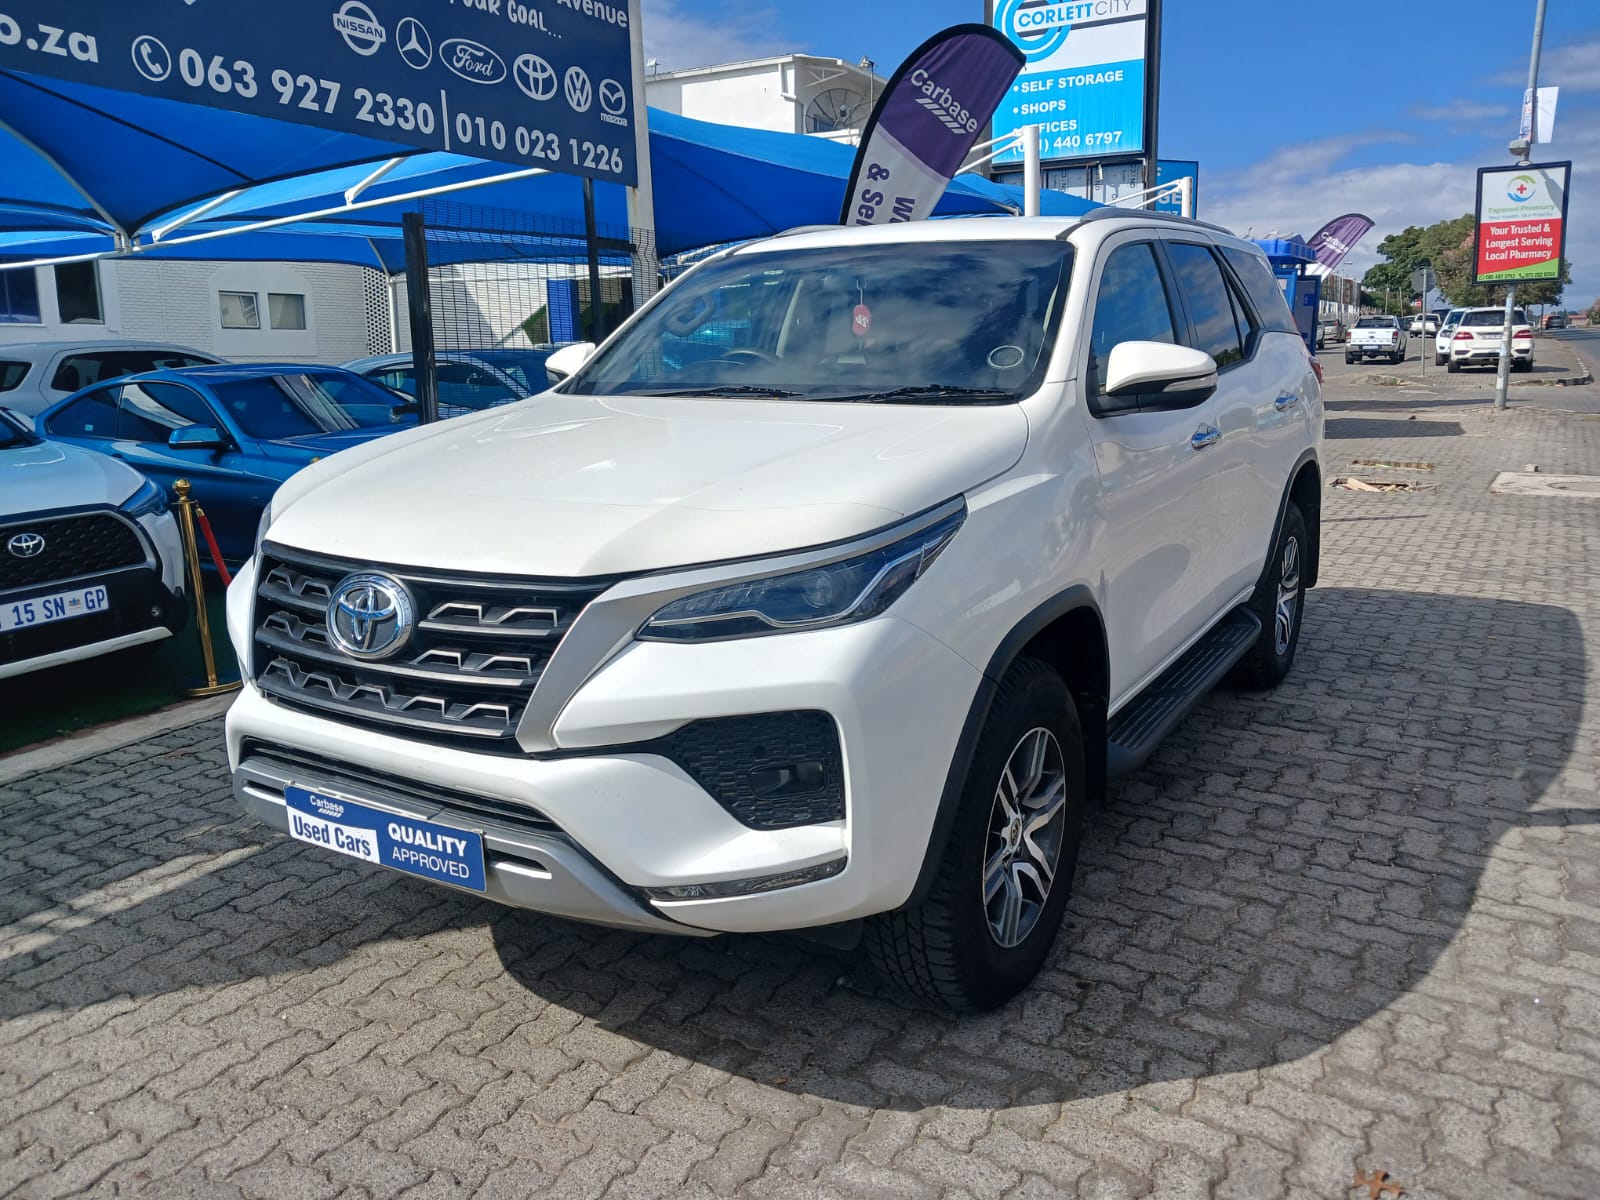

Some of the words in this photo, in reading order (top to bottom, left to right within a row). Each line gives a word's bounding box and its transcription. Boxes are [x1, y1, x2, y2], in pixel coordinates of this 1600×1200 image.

[336, 17, 383, 39] NISSAN
[452, 44, 493, 77] Ford
[178, 48, 258, 98] 063
[271, 68, 341, 114] 927
[353, 87, 435, 135] 2330
[1021, 79, 1054, 93] SELF
[1057, 70, 1125, 89] STORAGE
[910, 68, 978, 132] Carbase
[1020, 99, 1067, 115] SHOPS
[600, 112, 628, 127] mazda
[455, 112, 506, 151] 010
[515, 126, 561, 161] 023
[569, 137, 623, 174] 1226
[1053, 134, 1081, 149] 440
[1085, 130, 1123, 146] 6797
[866, 163, 890, 181] &
[1490, 226, 1509, 236] Your
[1510, 224, 1542, 235] Trusted
[1543, 222, 1551, 233] &
[1486, 238, 1519, 249] Longest
[1520, 236, 1553, 247] Serving
[1485, 251, 1508, 261] Local
[1509, 250, 1552, 260] Pharmacy
[12, 602, 36, 627] 15
[42, 596, 67, 620] SN
[84, 588, 105, 611] GP
[309, 795, 345, 814] Carbase
[292, 814, 331, 845] Used
[334, 826, 372, 857] Cars
[387, 822, 468, 858] QUALITY
[391, 846, 470, 880] APPROVED
